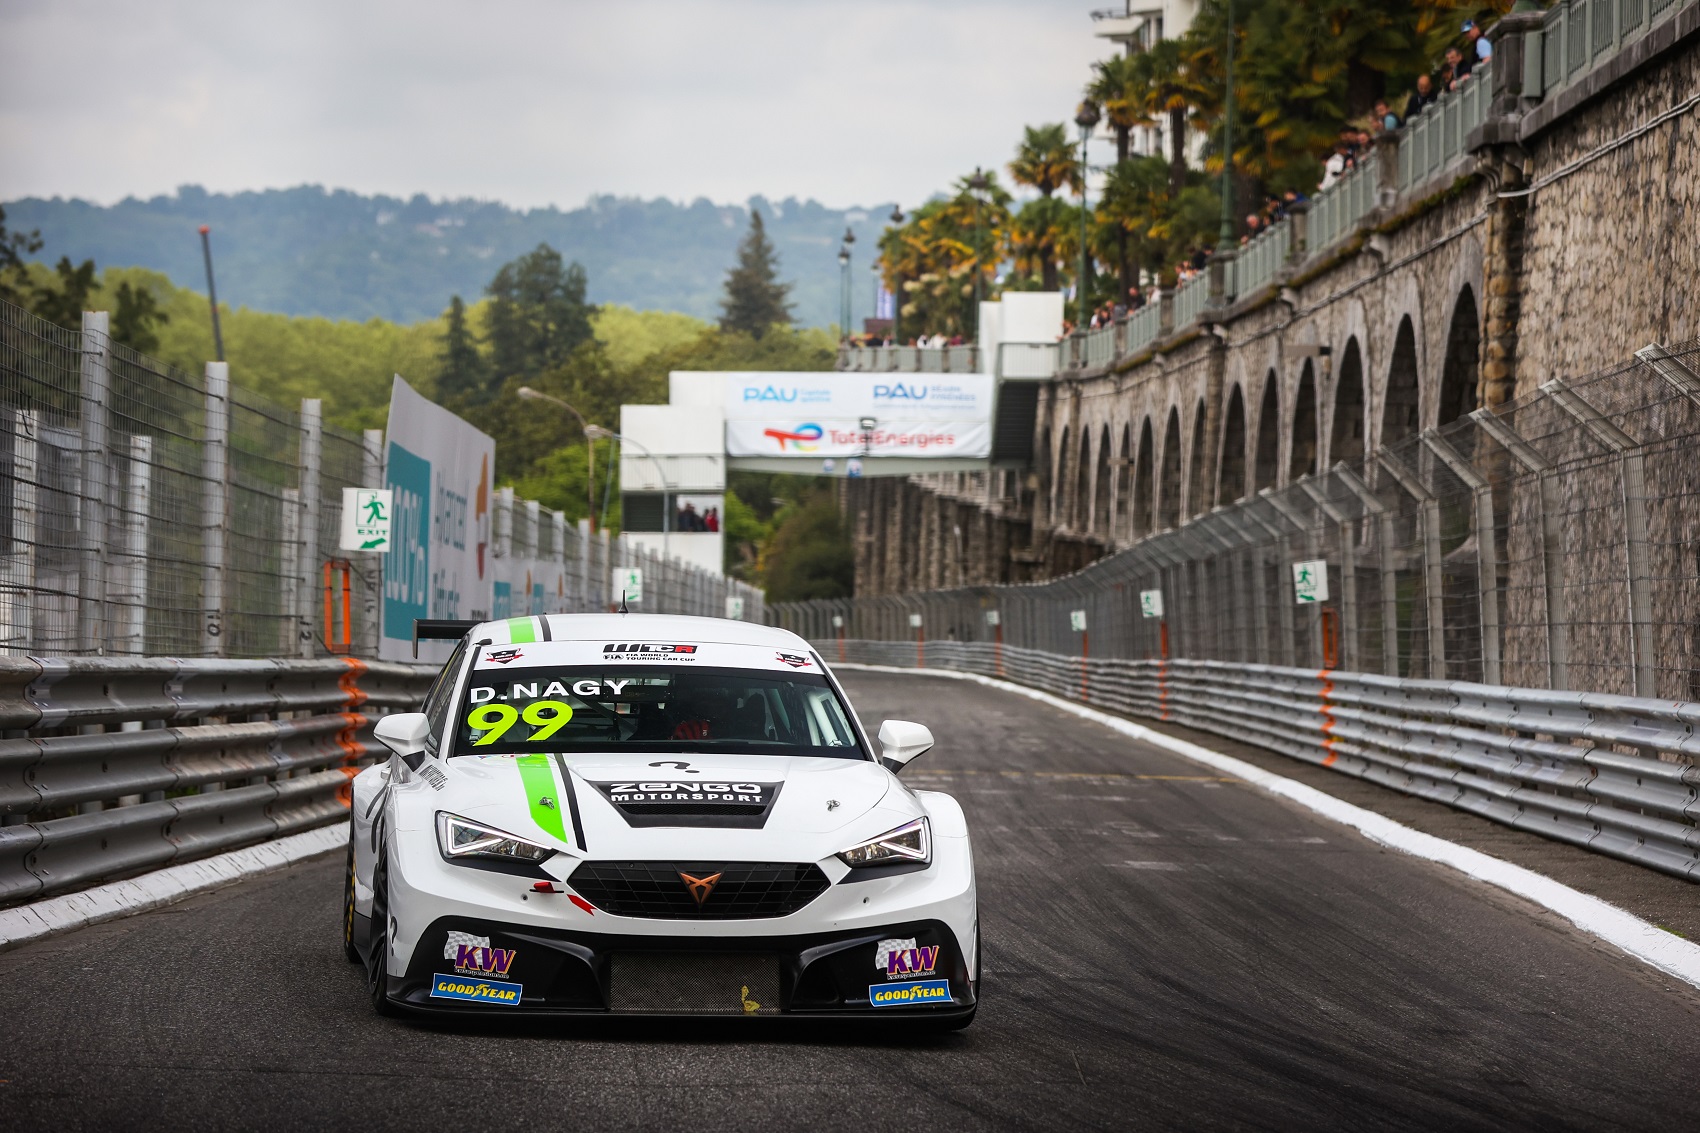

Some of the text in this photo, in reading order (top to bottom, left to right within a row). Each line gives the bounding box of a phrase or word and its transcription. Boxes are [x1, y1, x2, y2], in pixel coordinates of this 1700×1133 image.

[743, 386, 798, 402] PAU
[873, 383, 927, 400] PAU
[603, 643, 698, 654] WTCR
[470, 679, 630, 704] D.NAGY
[467, 700, 574, 747] 99
[610, 793, 763, 803] MOTORSPORT
[454, 943, 517, 974] KW
[886, 945, 940, 975] KW
[437, 981, 517, 1001] GOODYEAR
[875, 985, 946, 1002] GOODYEAR
